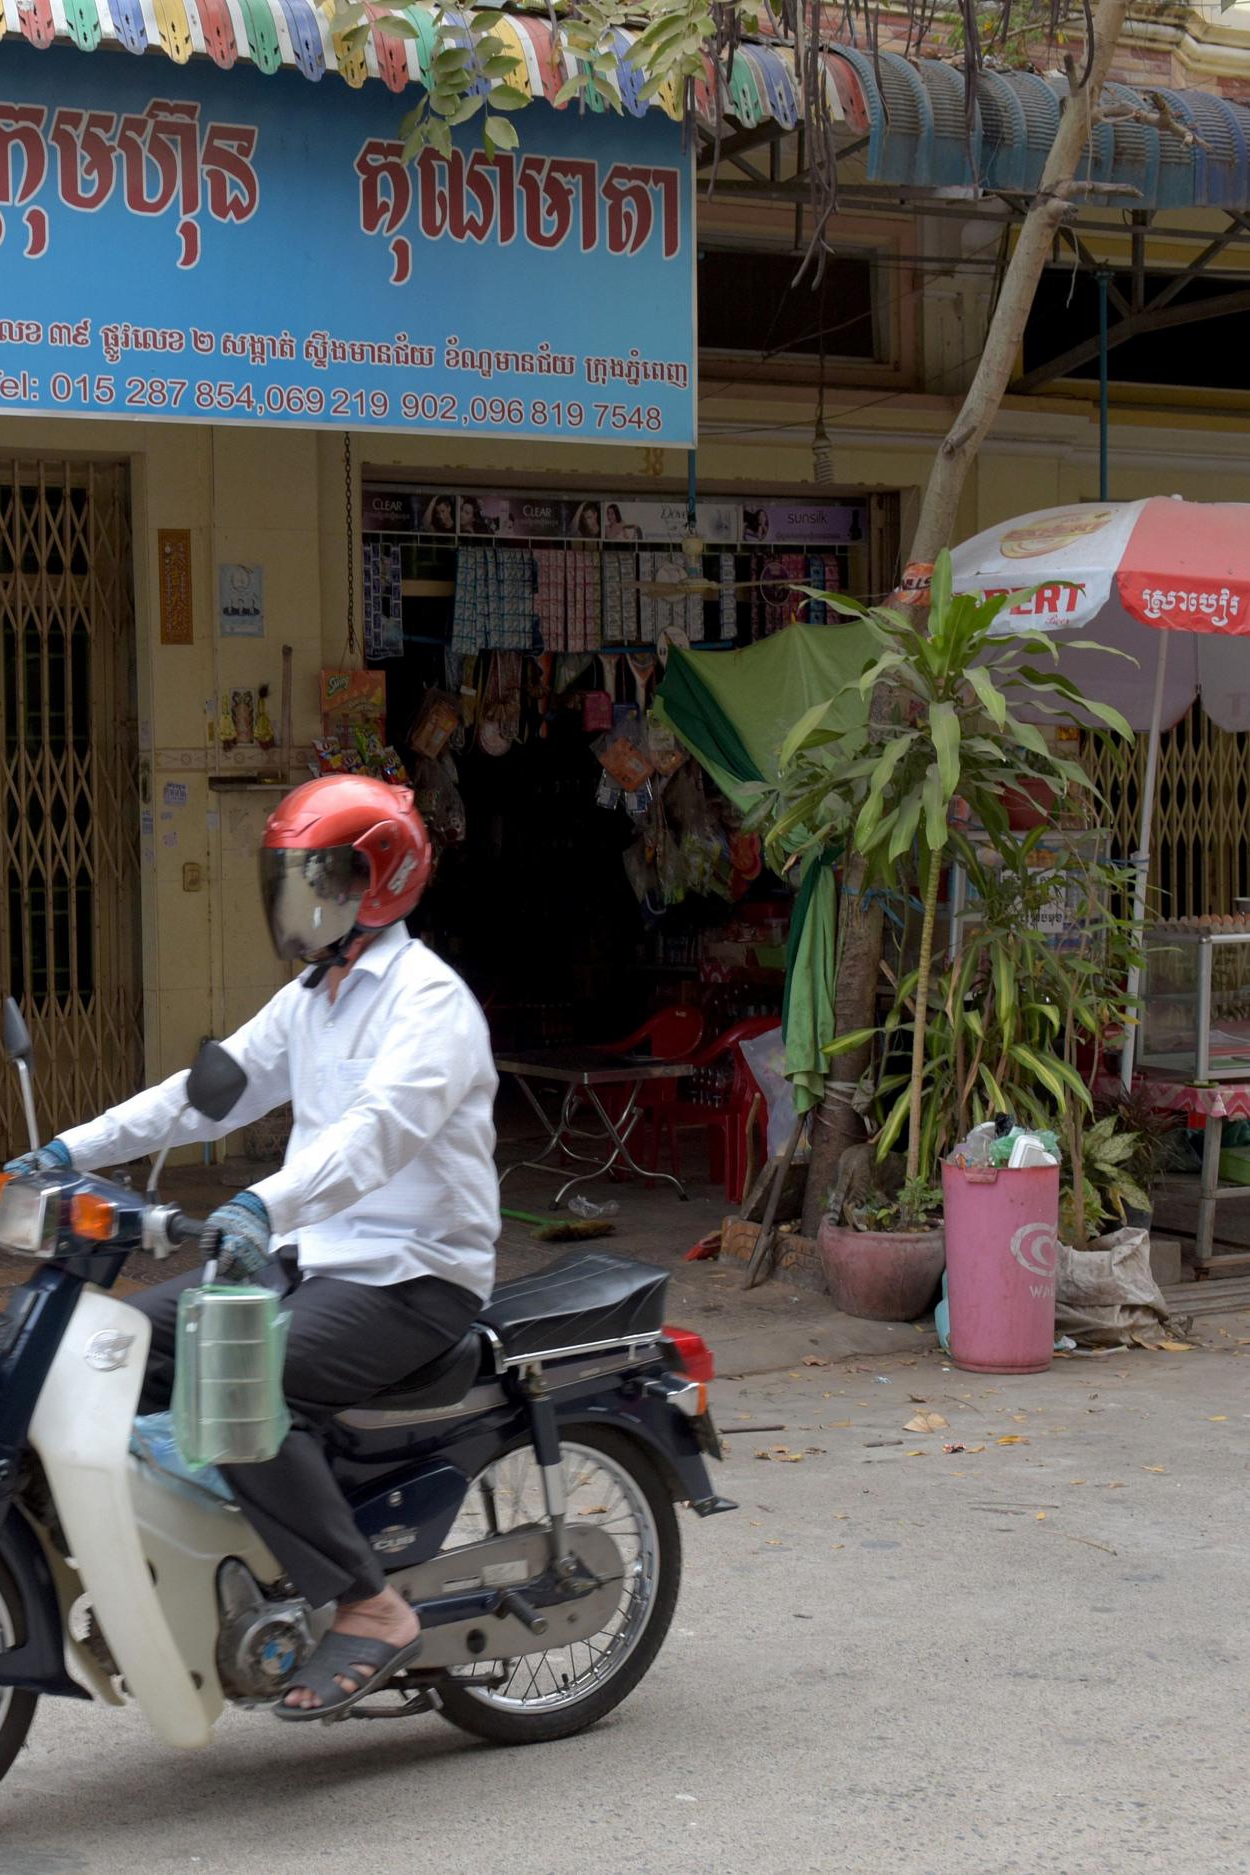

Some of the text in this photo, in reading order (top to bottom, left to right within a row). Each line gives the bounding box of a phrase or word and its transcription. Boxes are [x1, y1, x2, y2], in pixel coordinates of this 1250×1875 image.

[49, 318, 91, 347] ៣៩
[191, 328, 214, 353] ២
[51, 371, 115, 403] 015
[126, 377, 188, 407] 287
[331, 387, 388, 416] 219
[530, 400, 584, 427] 819
[593, 403, 662, 432] 7548
[371, 498, 403, 512] CLEAR
[522, 504, 552, 517] CLEAR
[787, 511, 829, 526] sunsilk
